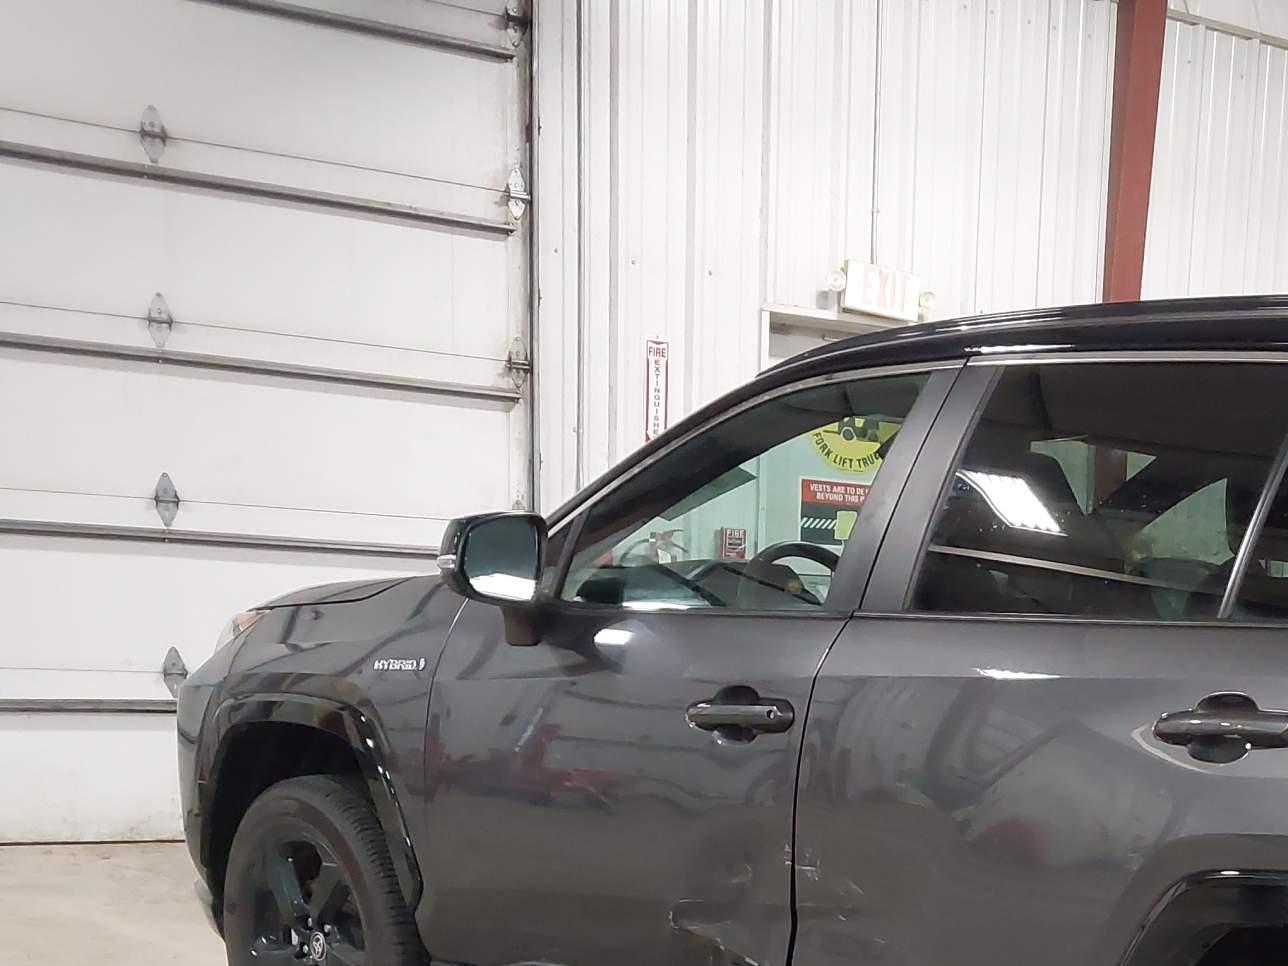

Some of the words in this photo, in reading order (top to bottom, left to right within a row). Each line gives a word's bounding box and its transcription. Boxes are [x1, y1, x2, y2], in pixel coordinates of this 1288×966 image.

[864, 266, 910, 312] EXIT
[649, 346, 666, 358] FIRE
[653, 359, 661, 435] EXTINGUISHE
[812, 432, 833, 459] FORK
[833, 454, 853, 468] LIFT
[856, 451, 880, 468] TRUC
[810, 484, 831, 492] VESTS
[816, 492, 843, 501] BEYOND
[727, 529, 744, 537] FIRE
[374, 658, 417, 670] HYBRID
